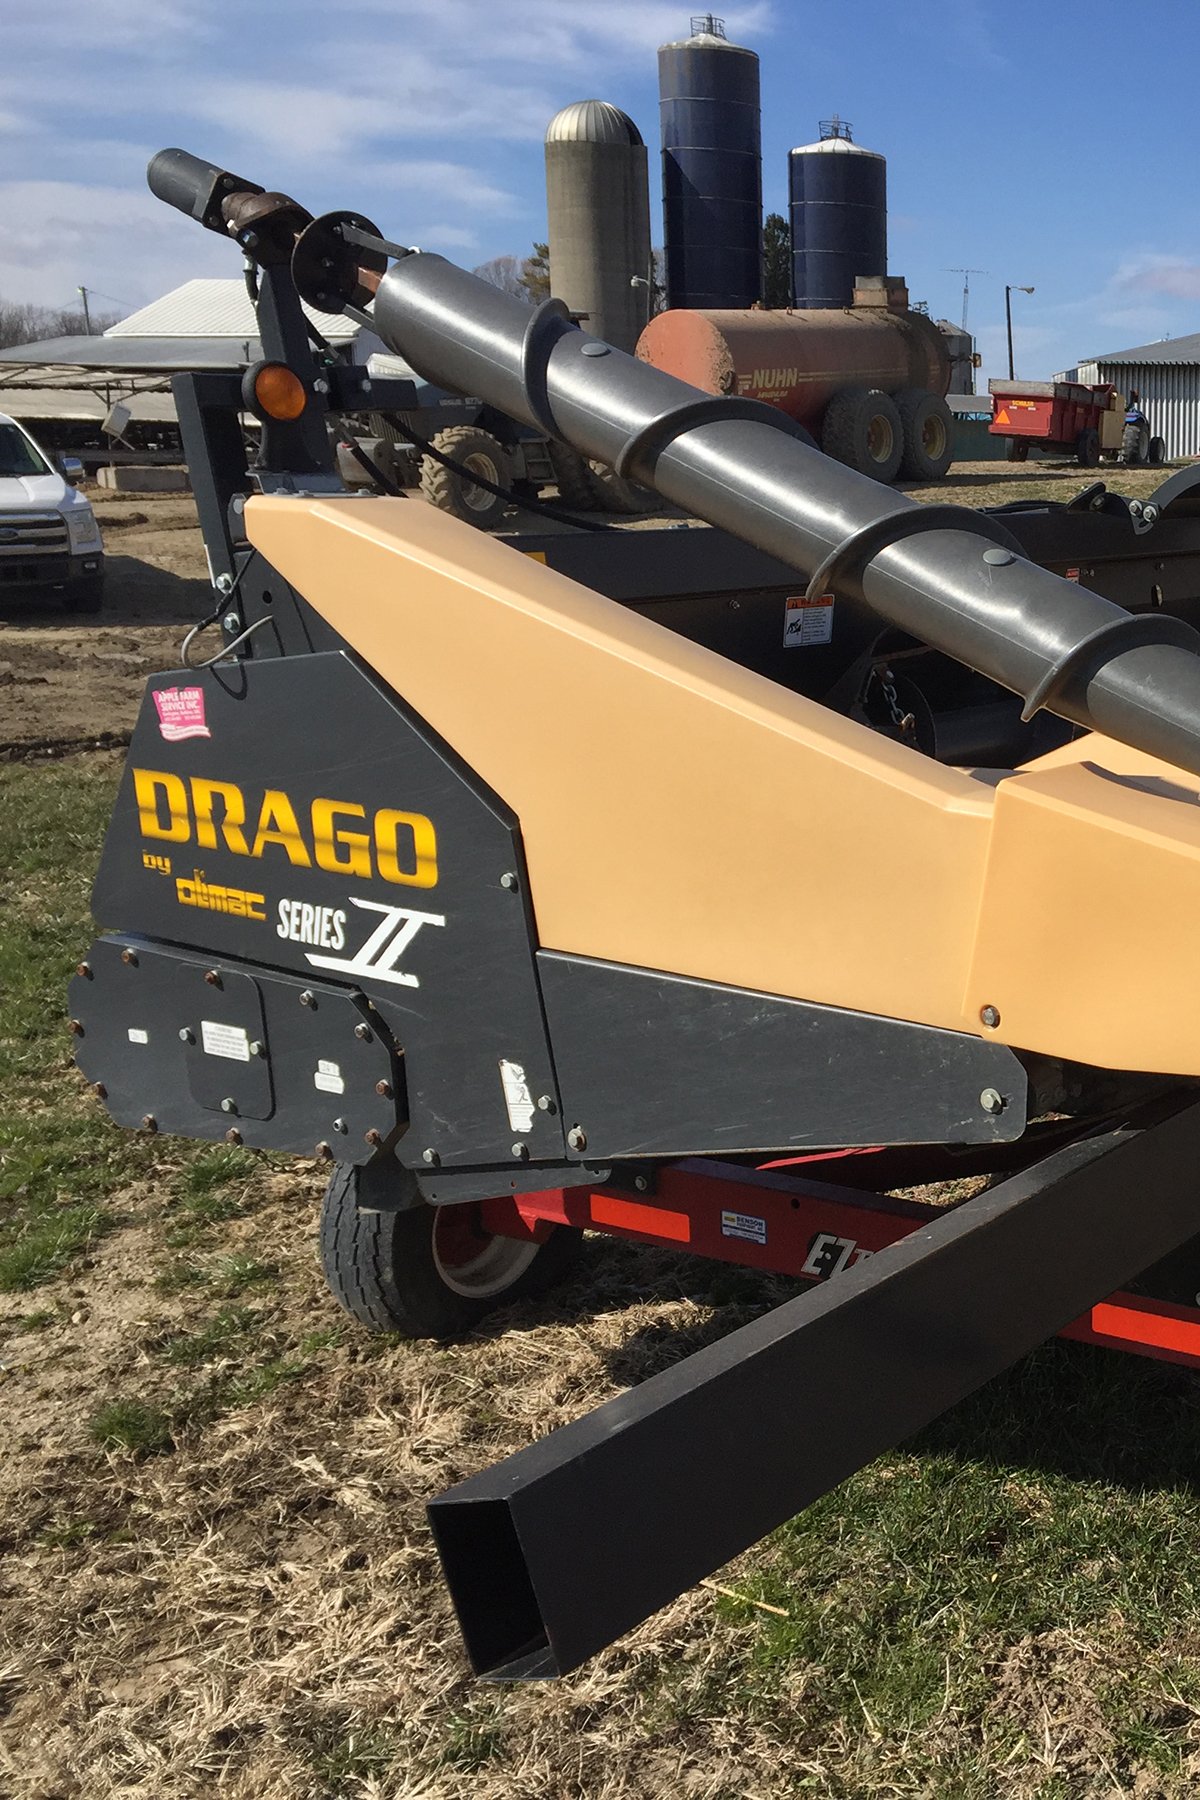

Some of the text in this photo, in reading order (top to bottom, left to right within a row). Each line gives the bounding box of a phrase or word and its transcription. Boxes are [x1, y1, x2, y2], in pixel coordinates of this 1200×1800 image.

[752, 368, 797, 389] NUHN
[158, 690, 201, 703] APPLE FARM
[160, 701, 186, 712] SERVICE
[132, 767, 439, 889] DRAGO
[276, 896, 446, 988] SERIES II
